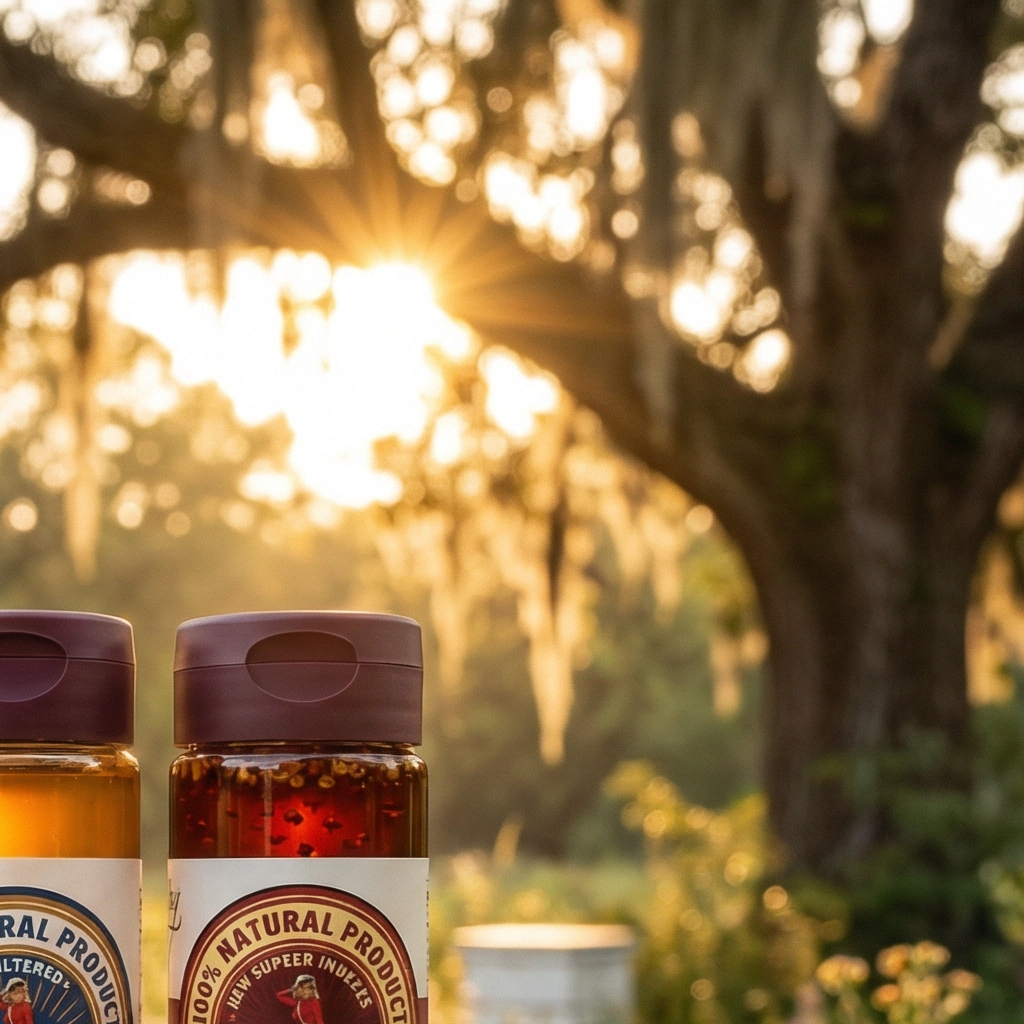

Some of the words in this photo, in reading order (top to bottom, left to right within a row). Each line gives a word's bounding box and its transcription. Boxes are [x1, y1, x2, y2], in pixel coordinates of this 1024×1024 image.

[192, 964, 222, 1024] 100%
[216, 910, 334, 964] NATURAL
[340, 921, 408, 1024] PRODUCT
[251, 952, 313, 980] SUPEER
